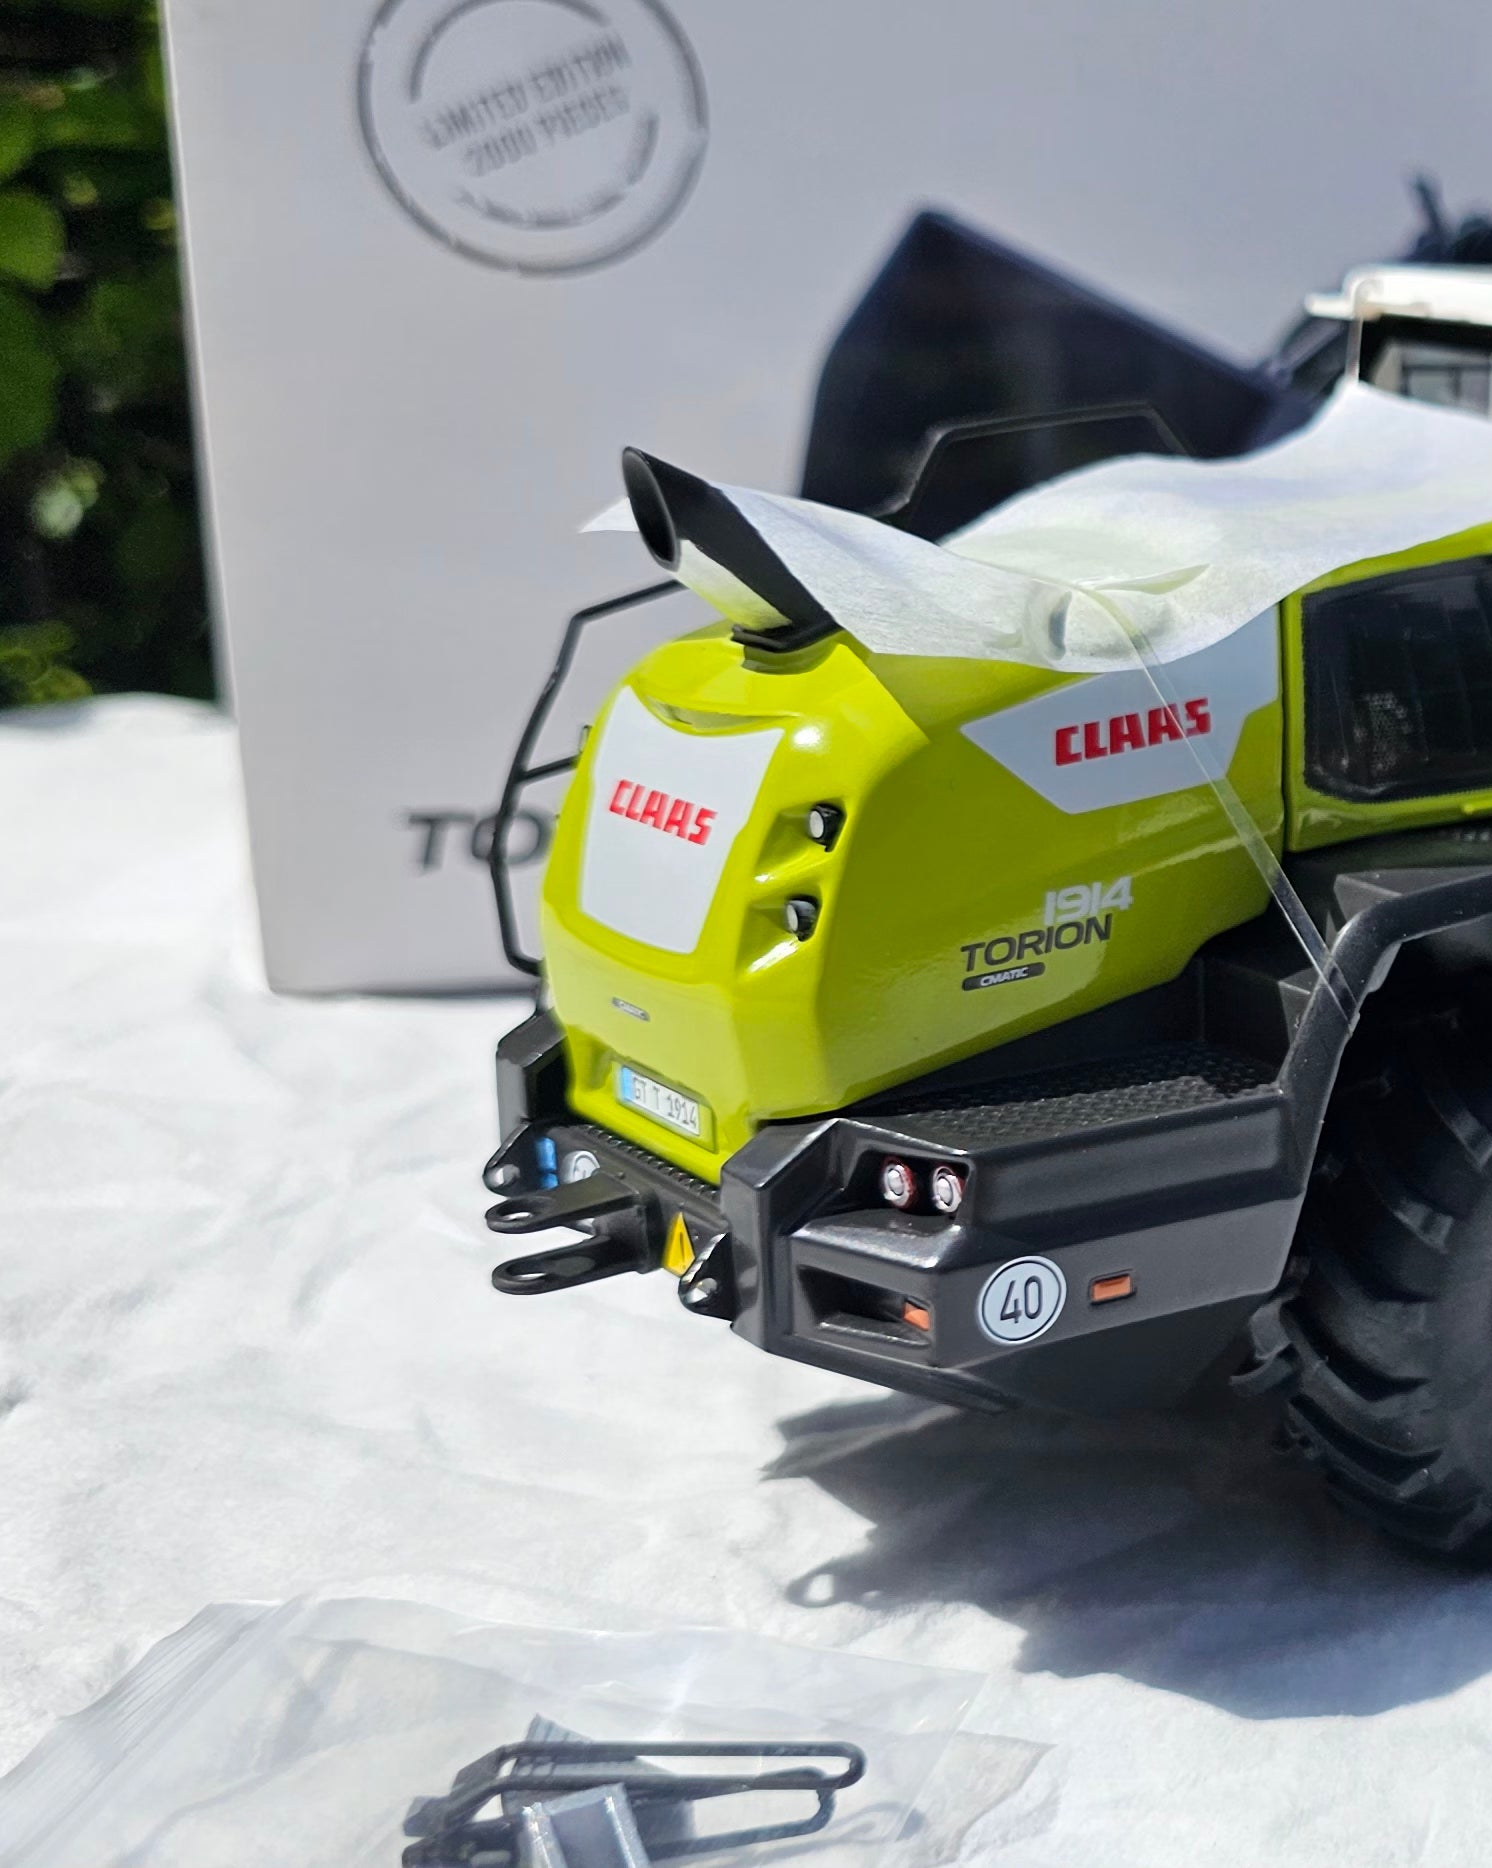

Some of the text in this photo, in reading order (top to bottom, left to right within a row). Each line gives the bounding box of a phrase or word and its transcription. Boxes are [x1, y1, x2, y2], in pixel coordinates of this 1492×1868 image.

[420, 32, 632, 151] LIMITED EDITION
[1055, 697, 1212, 767] CLAAS
[609, 779, 718, 846] CLAAS
[1043, 876, 1134, 926] 1914
[960, 913, 1113, 972] TORION
[980, 965, 1029, 987] CMATIC
[666, 1094, 697, 1128] 1914
[1000, 1275, 1043, 1324] 40
